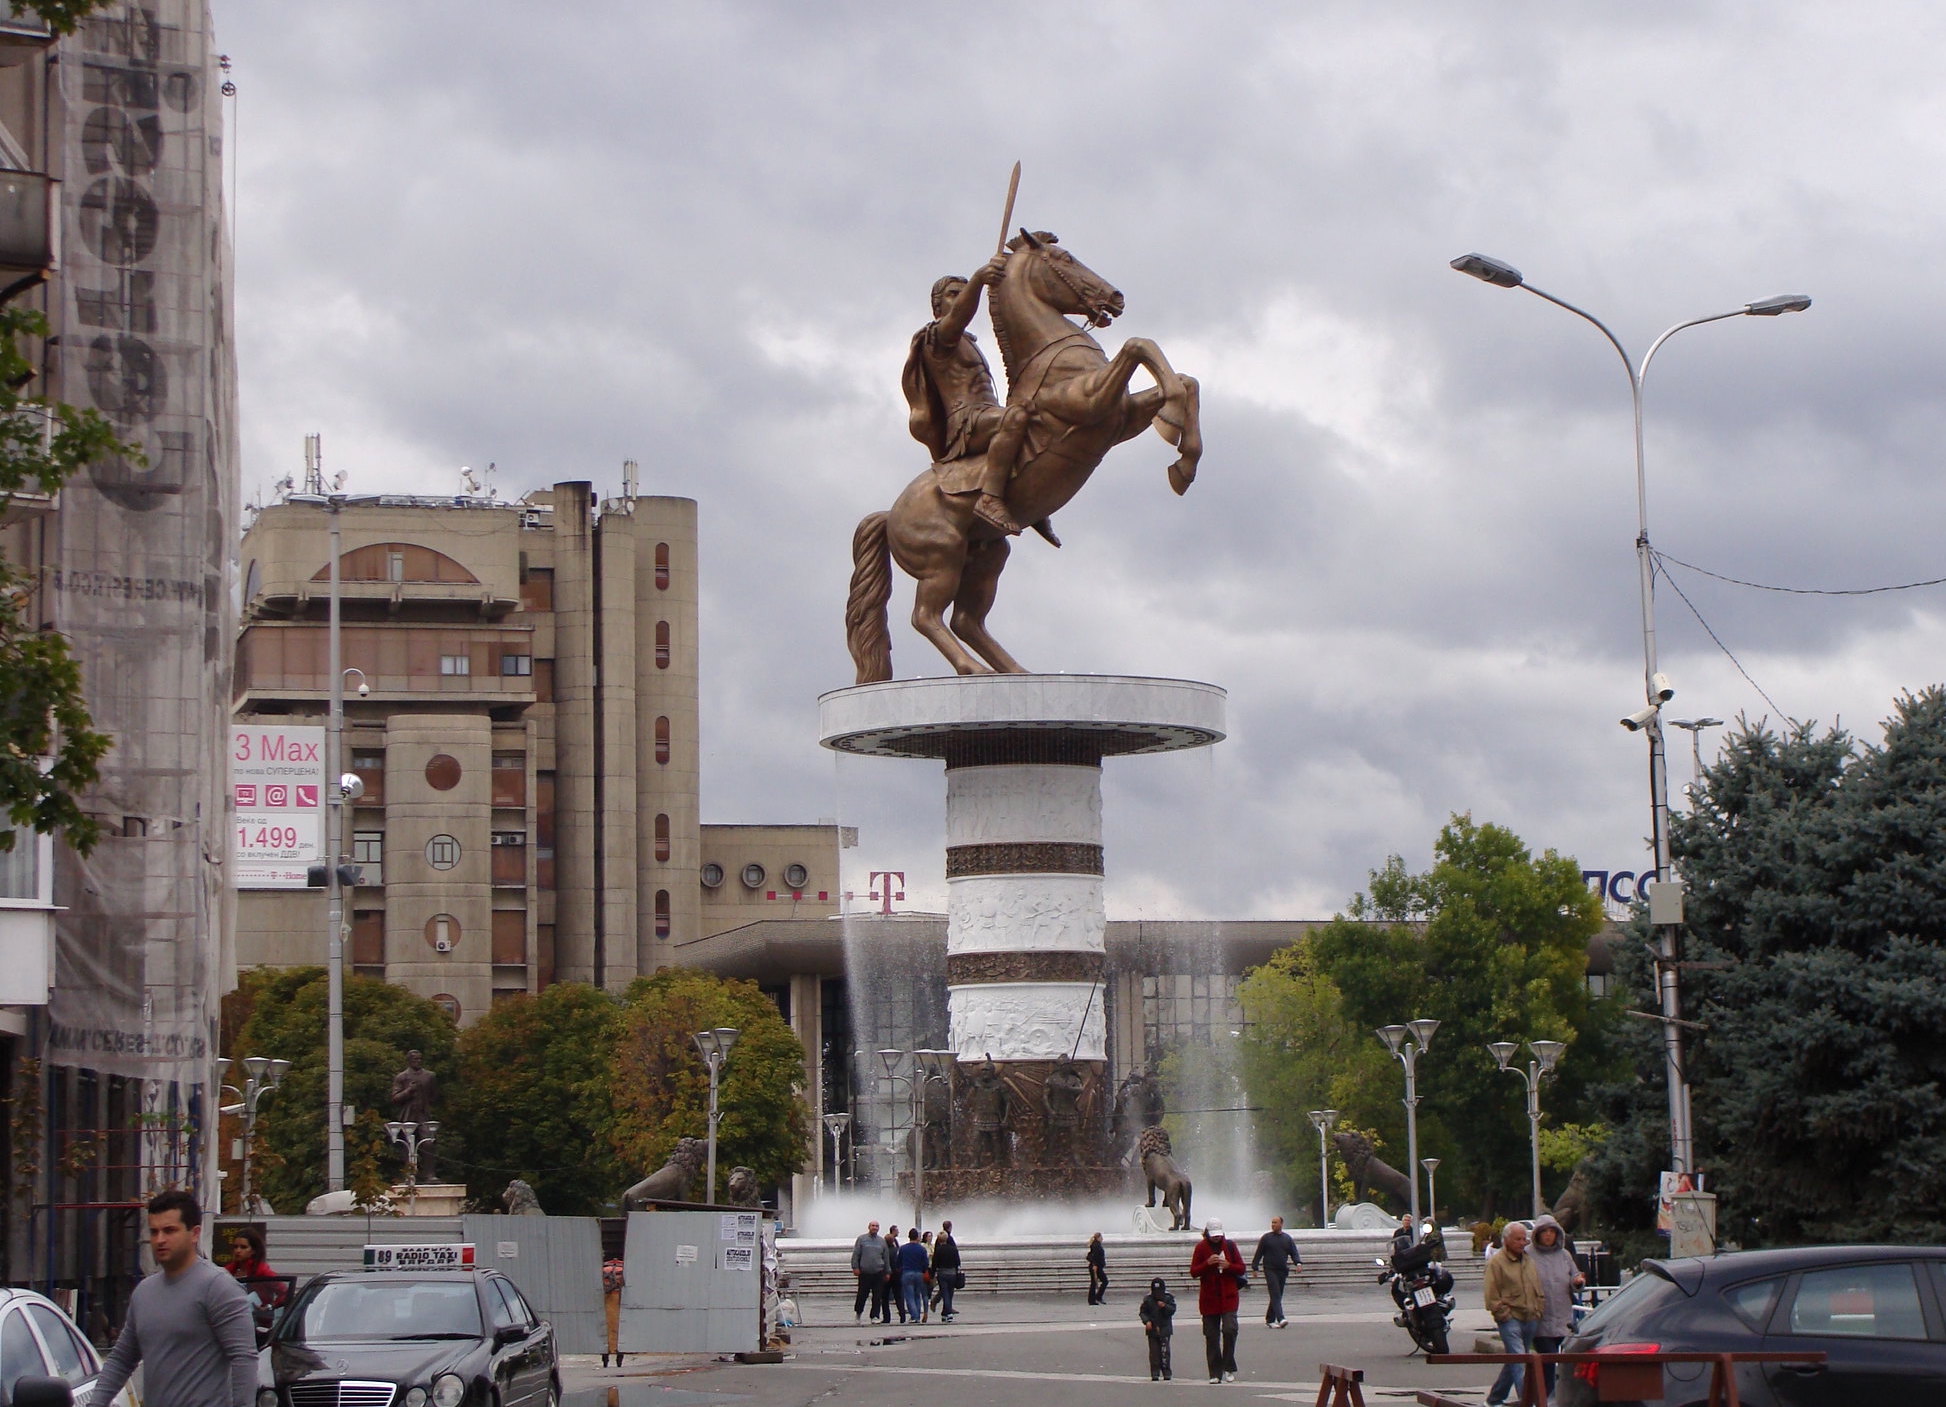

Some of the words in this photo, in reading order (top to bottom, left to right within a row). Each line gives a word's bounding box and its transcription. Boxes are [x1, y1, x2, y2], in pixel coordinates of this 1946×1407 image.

[235, 733, 250, 761] 3
[261, 734, 319, 762] Max
[238, 826, 297, 848] 1.499
[869, 871, 905, 915] T
[378, 1250, 392, 1263] 89
[396, 1252, 429, 1260] RADIO
[434, 1251, 458, 1259] TAXI
